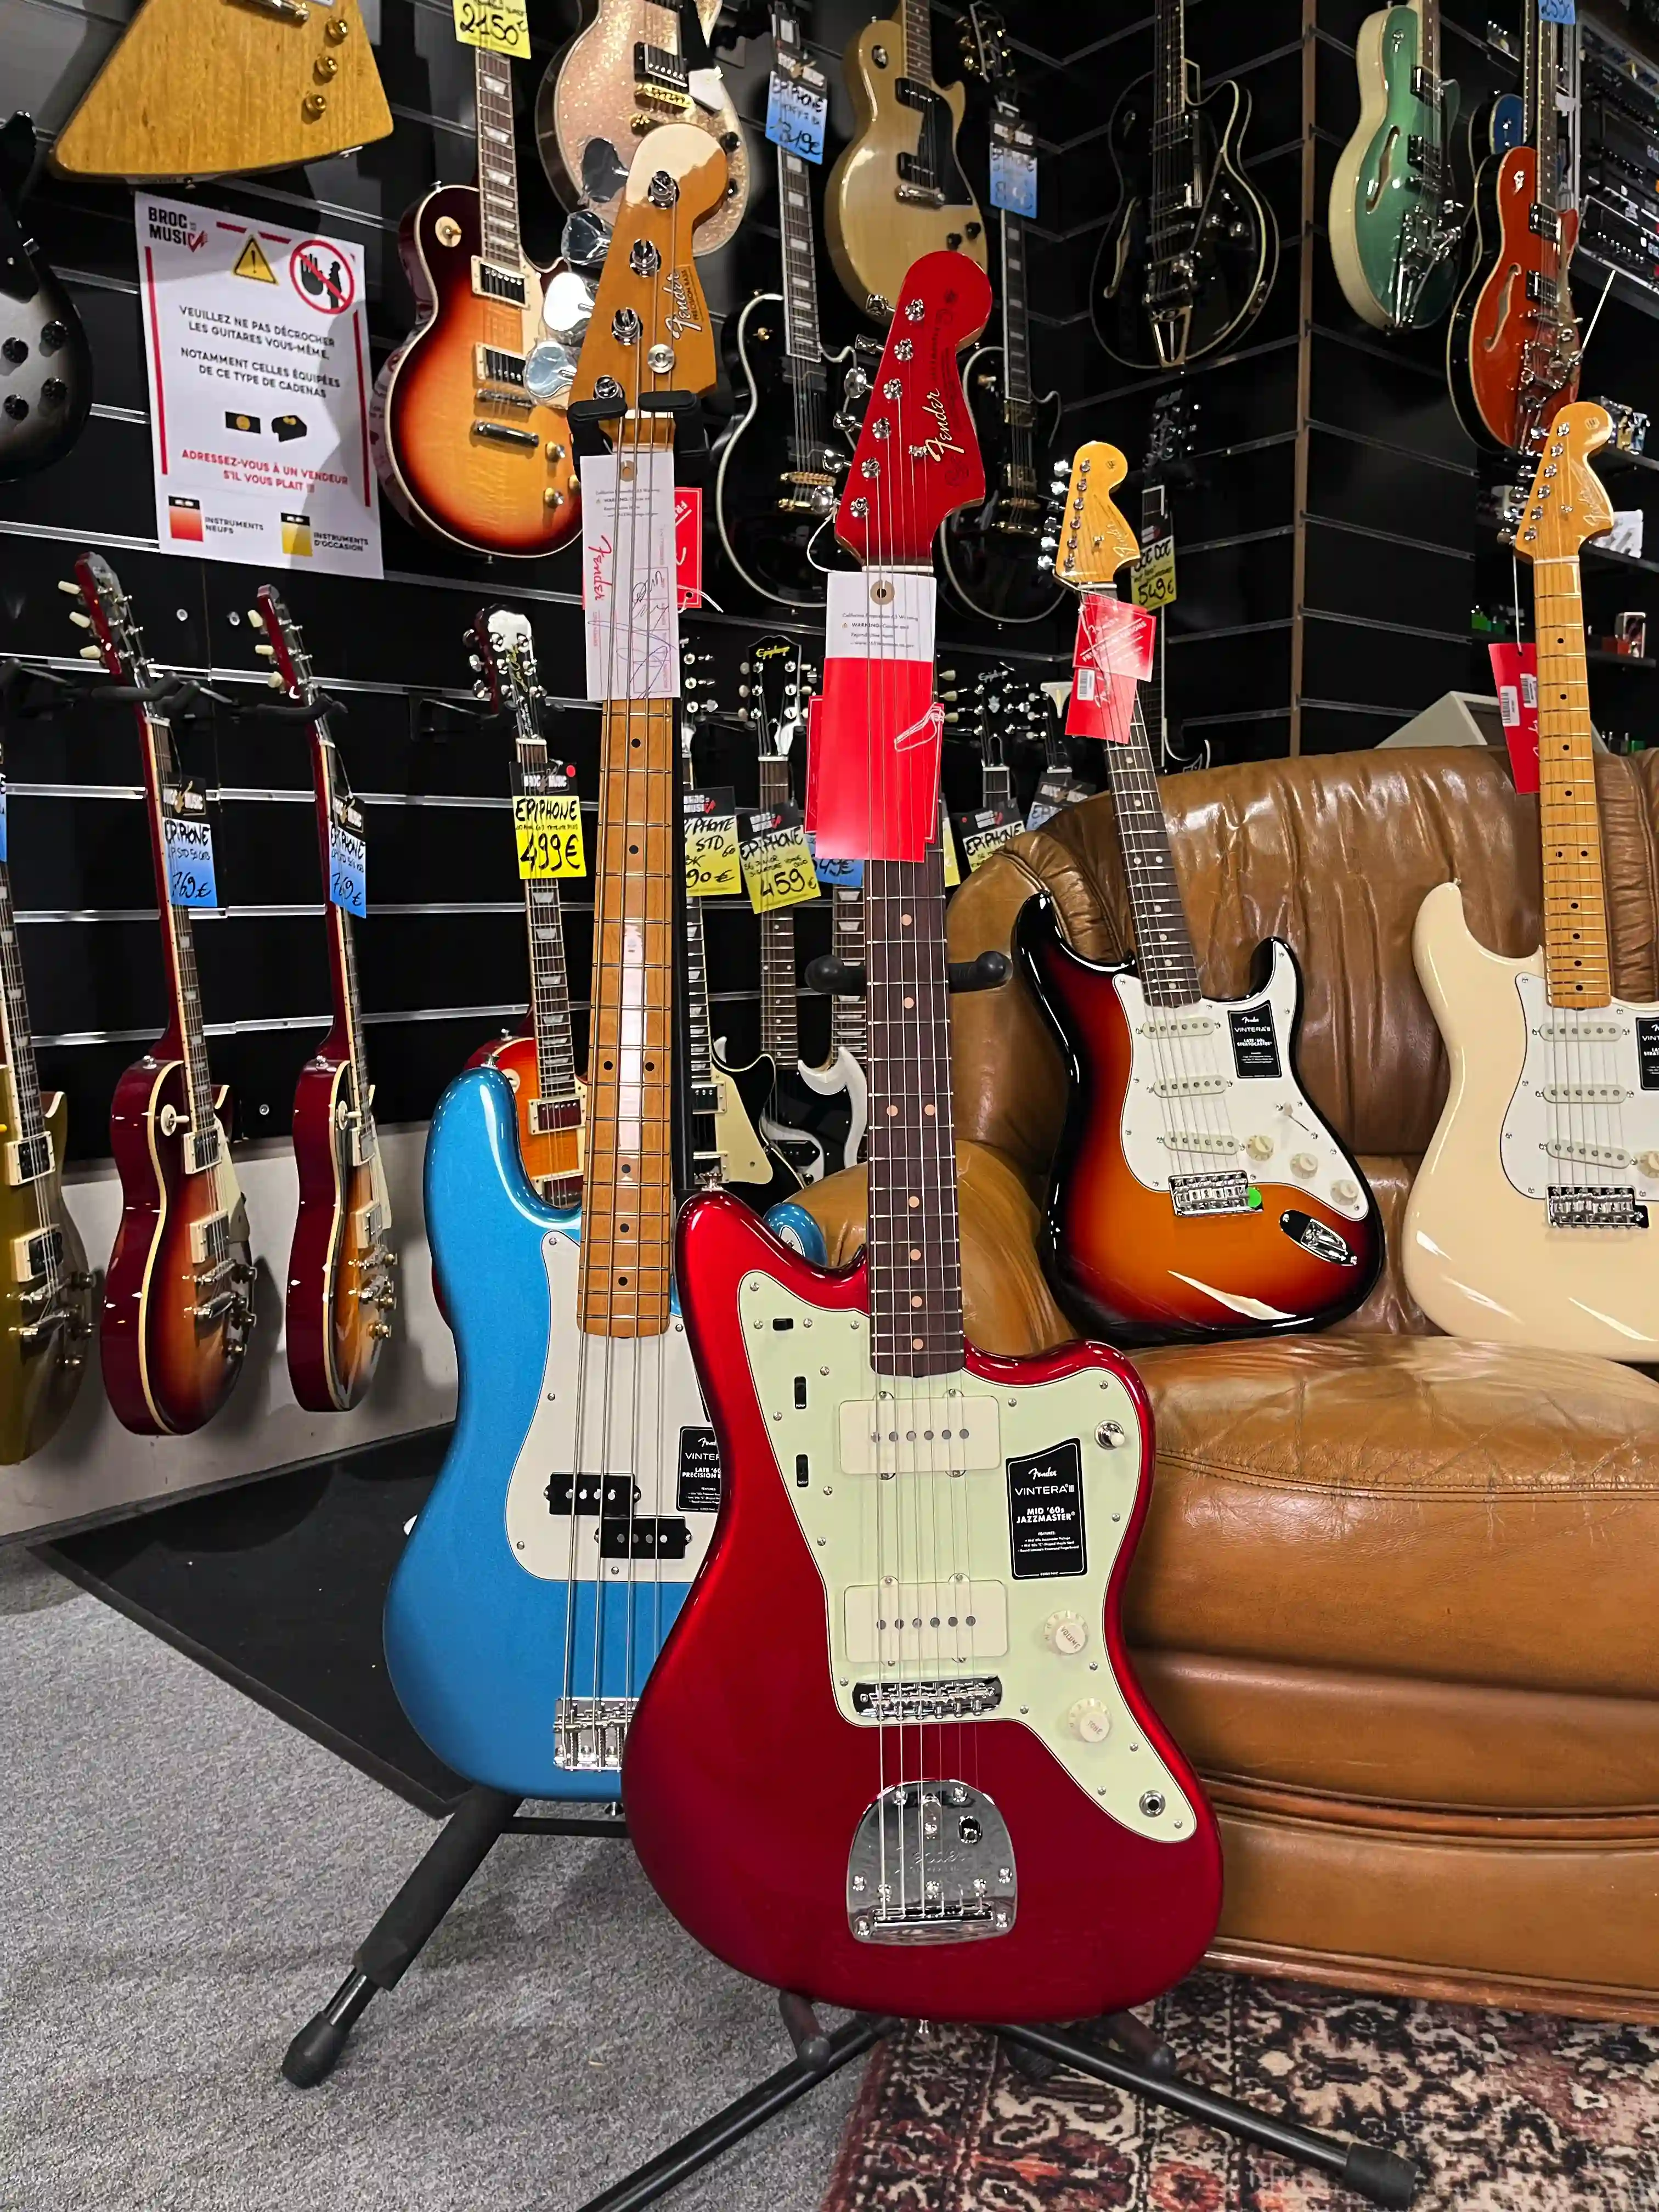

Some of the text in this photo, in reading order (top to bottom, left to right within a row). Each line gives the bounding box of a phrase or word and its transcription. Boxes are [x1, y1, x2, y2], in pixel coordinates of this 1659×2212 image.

[148, 206, 188, 229] BROC
[149, 223, 200, 252] MUSIC
[663, 268, 702, 339] Fender
[179, 305, 335, 347] VEUILLEZ NE PAS DÉCROCHER
[189, 321, 208, 334] LES
[212, 326, 262, 345] GUITARES
[180, 347, 341, 387] NOTAMMENT CELLES ÉQUIPÉES
[199, 365, 326, 398] DE CE TYPE DE CADENAS
[922, 387, 965, 462] Fender
[182, 449, 270, 472] ADRESSEZ-VOUS
[283, 466, 298, 477] UN
[301, 469, 348, 485] VENDEUR
[245, 473, 273, 486] VOUS
[276, 478, 303, 491] PLAIT
[205, 517, 264, 531] INSTRUMENTS
[205, 524, 234, 534] NEUFS
[314, 532, 369, 546] INSTRUMENTS
[588, 535, 613, 601] Fender
[516, 798, 578, 823] EPIPHONE
[520, 833, 580, 872] 499€
[696, 835, 724, 853] STD
[685, 868, 736, 889] 90€
[698, 1437, 717, 1447] Fend
[1028, 1466, 1057, 1480] Fender
[1026, 1507, 1044, 1515] MID
[1061, 1626, 1081, 1650] VOLUME
[1087, 1720, 1103, 1735] TONE
